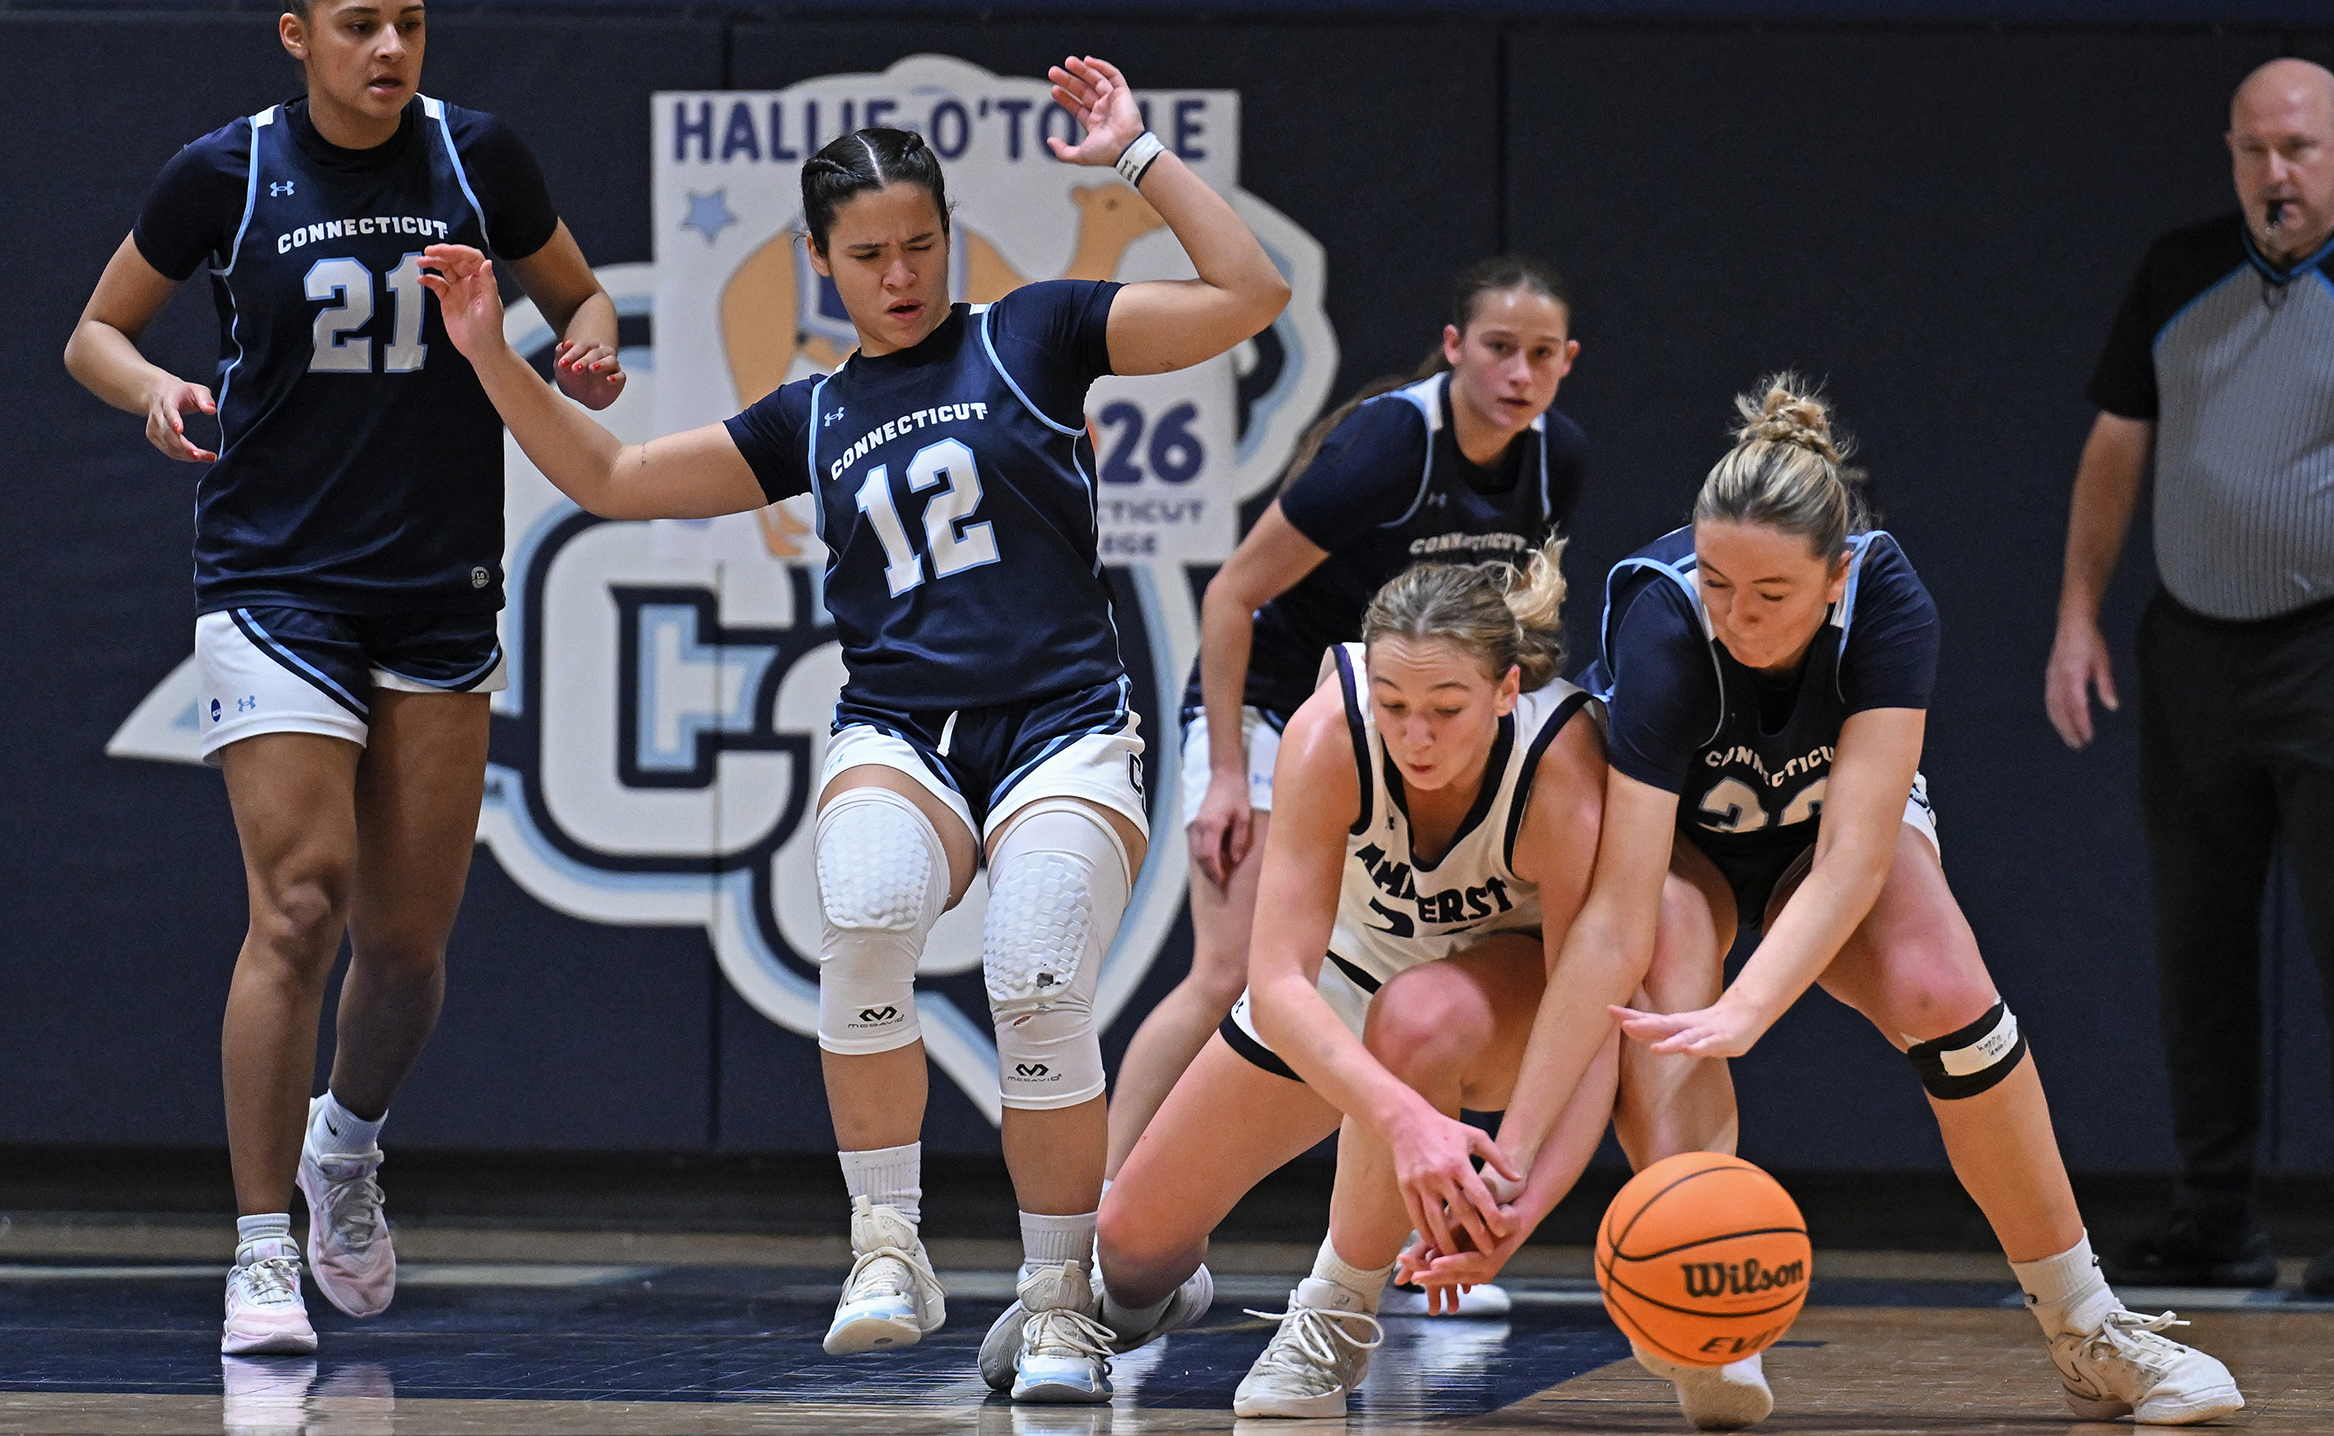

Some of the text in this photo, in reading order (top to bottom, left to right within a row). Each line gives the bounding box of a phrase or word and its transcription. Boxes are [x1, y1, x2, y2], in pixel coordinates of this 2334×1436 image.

[277, 216, 447, 254] CONNECTICUT
[303, 251, 428, 373] 21
[830, 402, 988, 480] CONNECTICUT
[855, 437, 1001, 598] 12
[1680, 1257, 1805, 1297] Wilson
